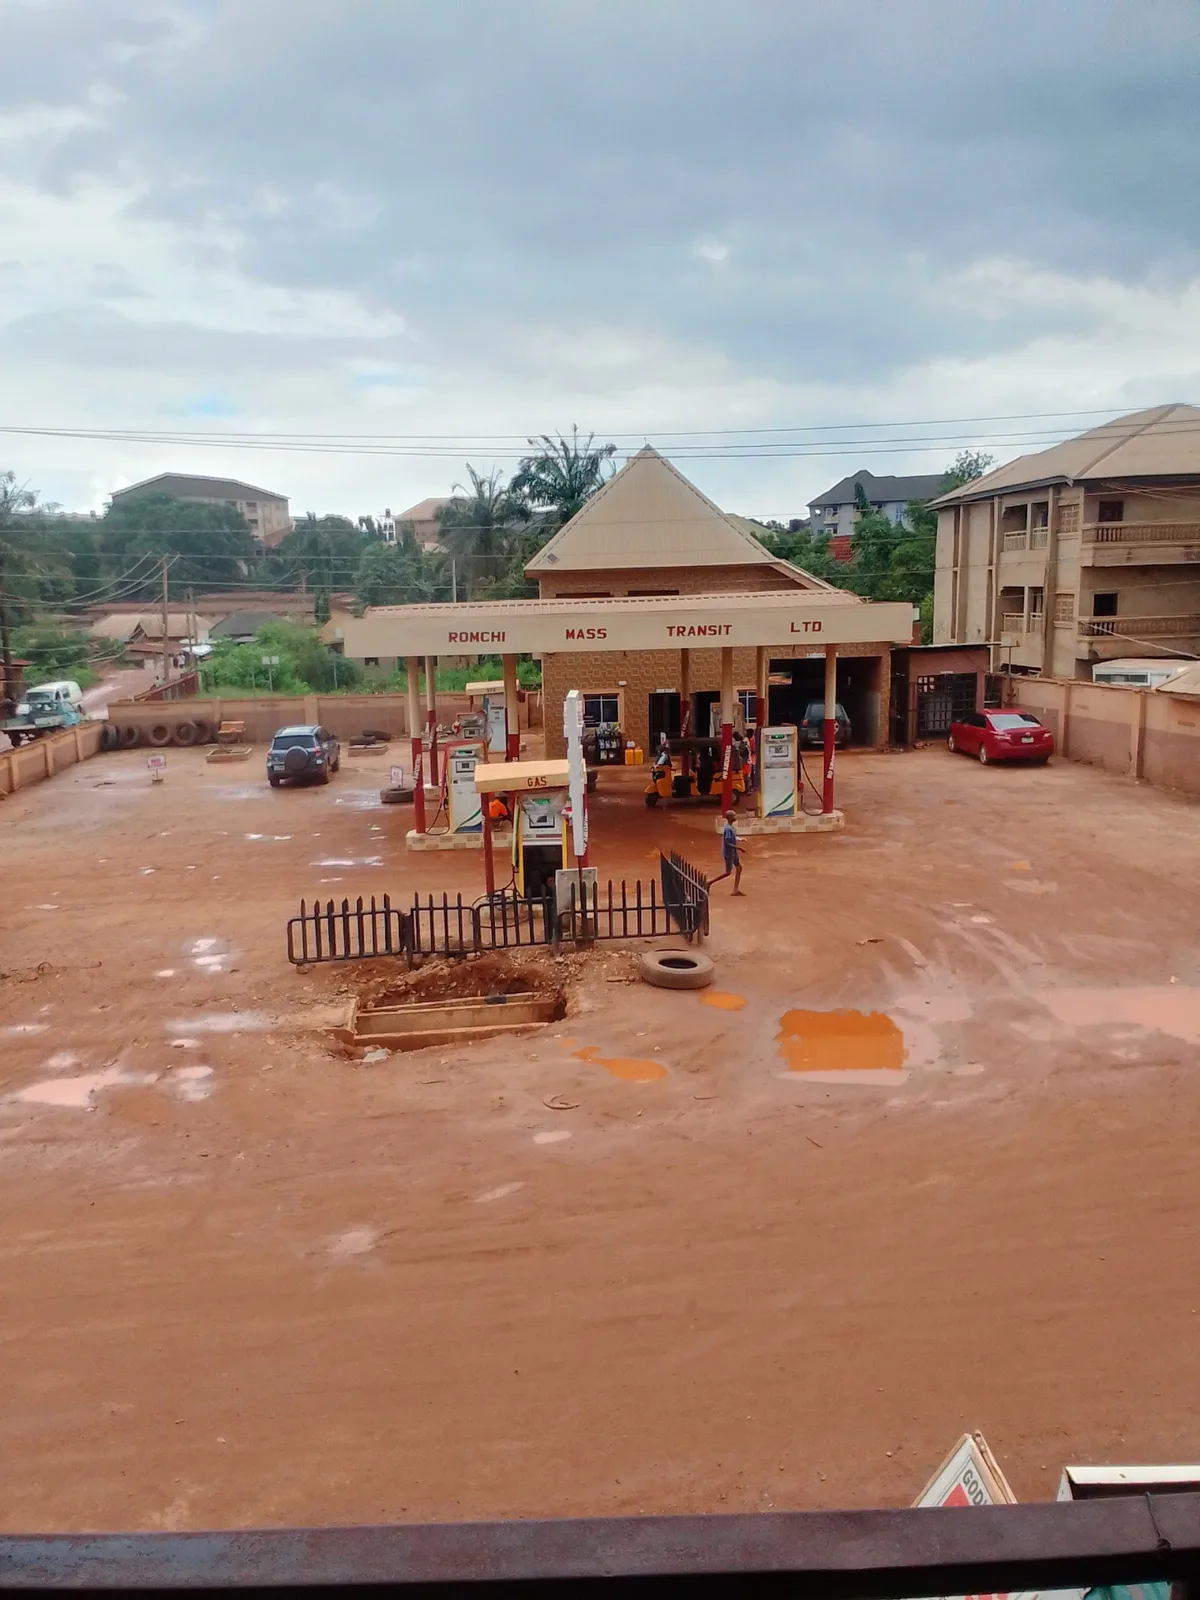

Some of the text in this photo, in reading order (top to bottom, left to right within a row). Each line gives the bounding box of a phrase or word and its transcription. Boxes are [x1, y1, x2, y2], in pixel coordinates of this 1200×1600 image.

[448, 631, 506, 643] ROMCHI
[565, 628, 608, 640] MASS
[666, 624, 733, 637] TRANSIT
[527, 776, 547, 787] GAS
[963, 1469, 987, 1505] GOD
